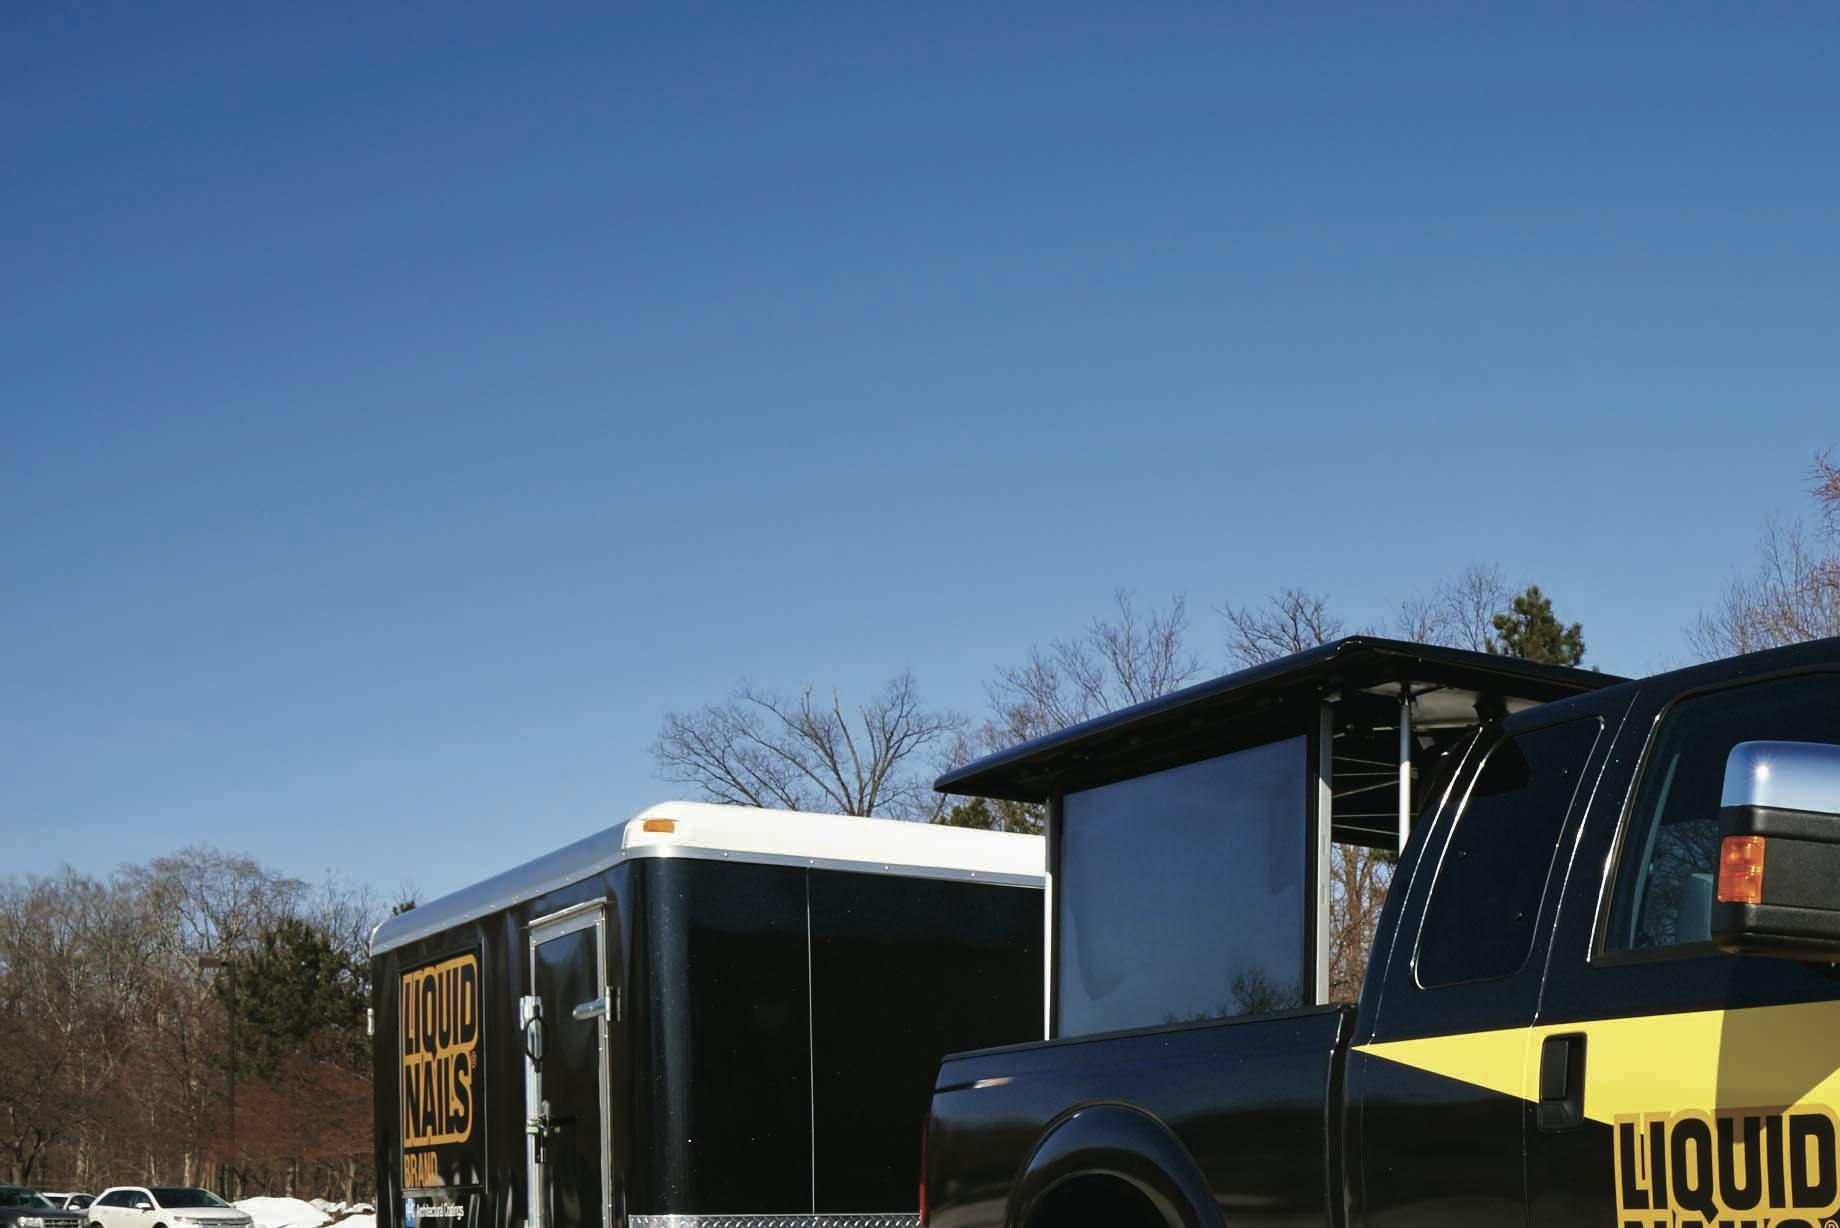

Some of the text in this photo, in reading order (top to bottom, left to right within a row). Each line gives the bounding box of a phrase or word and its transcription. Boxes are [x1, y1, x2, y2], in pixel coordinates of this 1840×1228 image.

[404, 962, 476, 1057] LIQUID
[403, 1151, 438, 1188] BRAND
[1617, 1112, 1840, 1224] LIQUID
